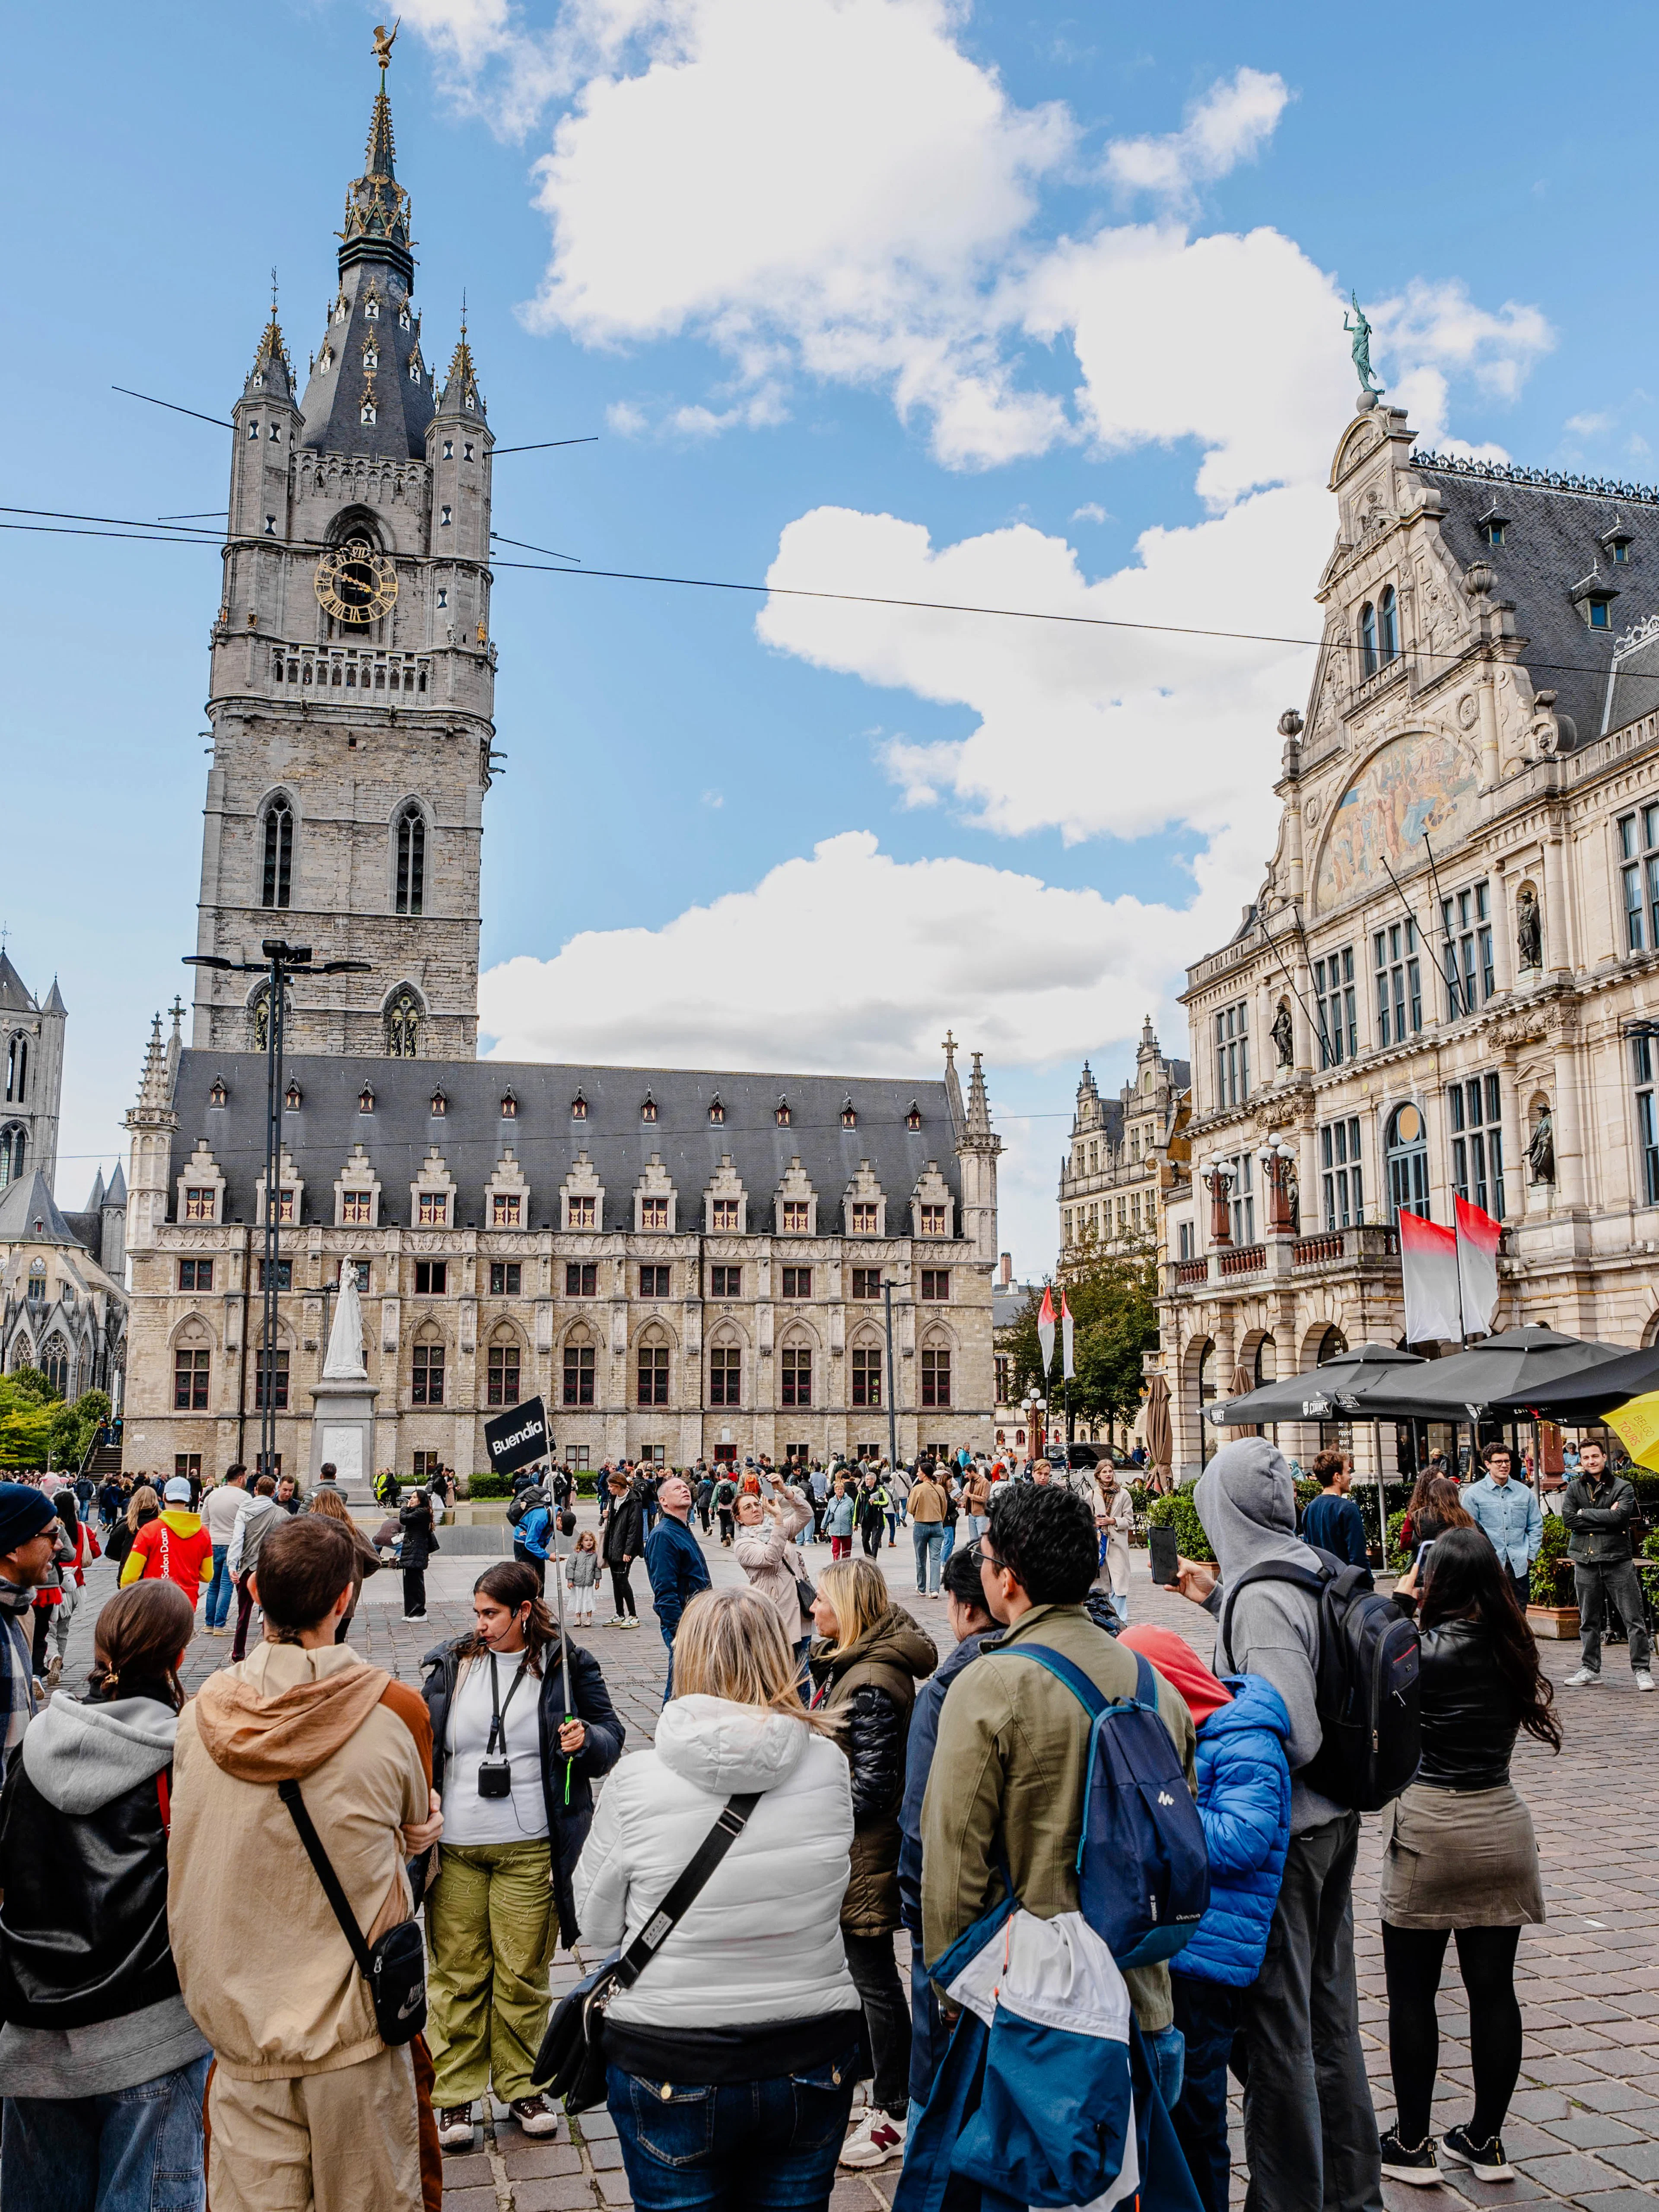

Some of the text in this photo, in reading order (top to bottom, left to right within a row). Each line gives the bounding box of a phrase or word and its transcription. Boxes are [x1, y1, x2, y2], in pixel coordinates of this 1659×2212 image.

[1309, 1401, 1329, 1415] CORNET
[1338, 1395, 1360, 1407] ORNET
[1211, 1411, 1224, 1421] ORNET
[1338, 1429, 1351, 1437] ripped
[1618, 1421, 1640, 1446] TOURS
[1634, 1415, 1654, 1437] BELGO
[492, 1420, 543, 1456] Buendía
[160, 1528, 169, 1579] Salon Daan
